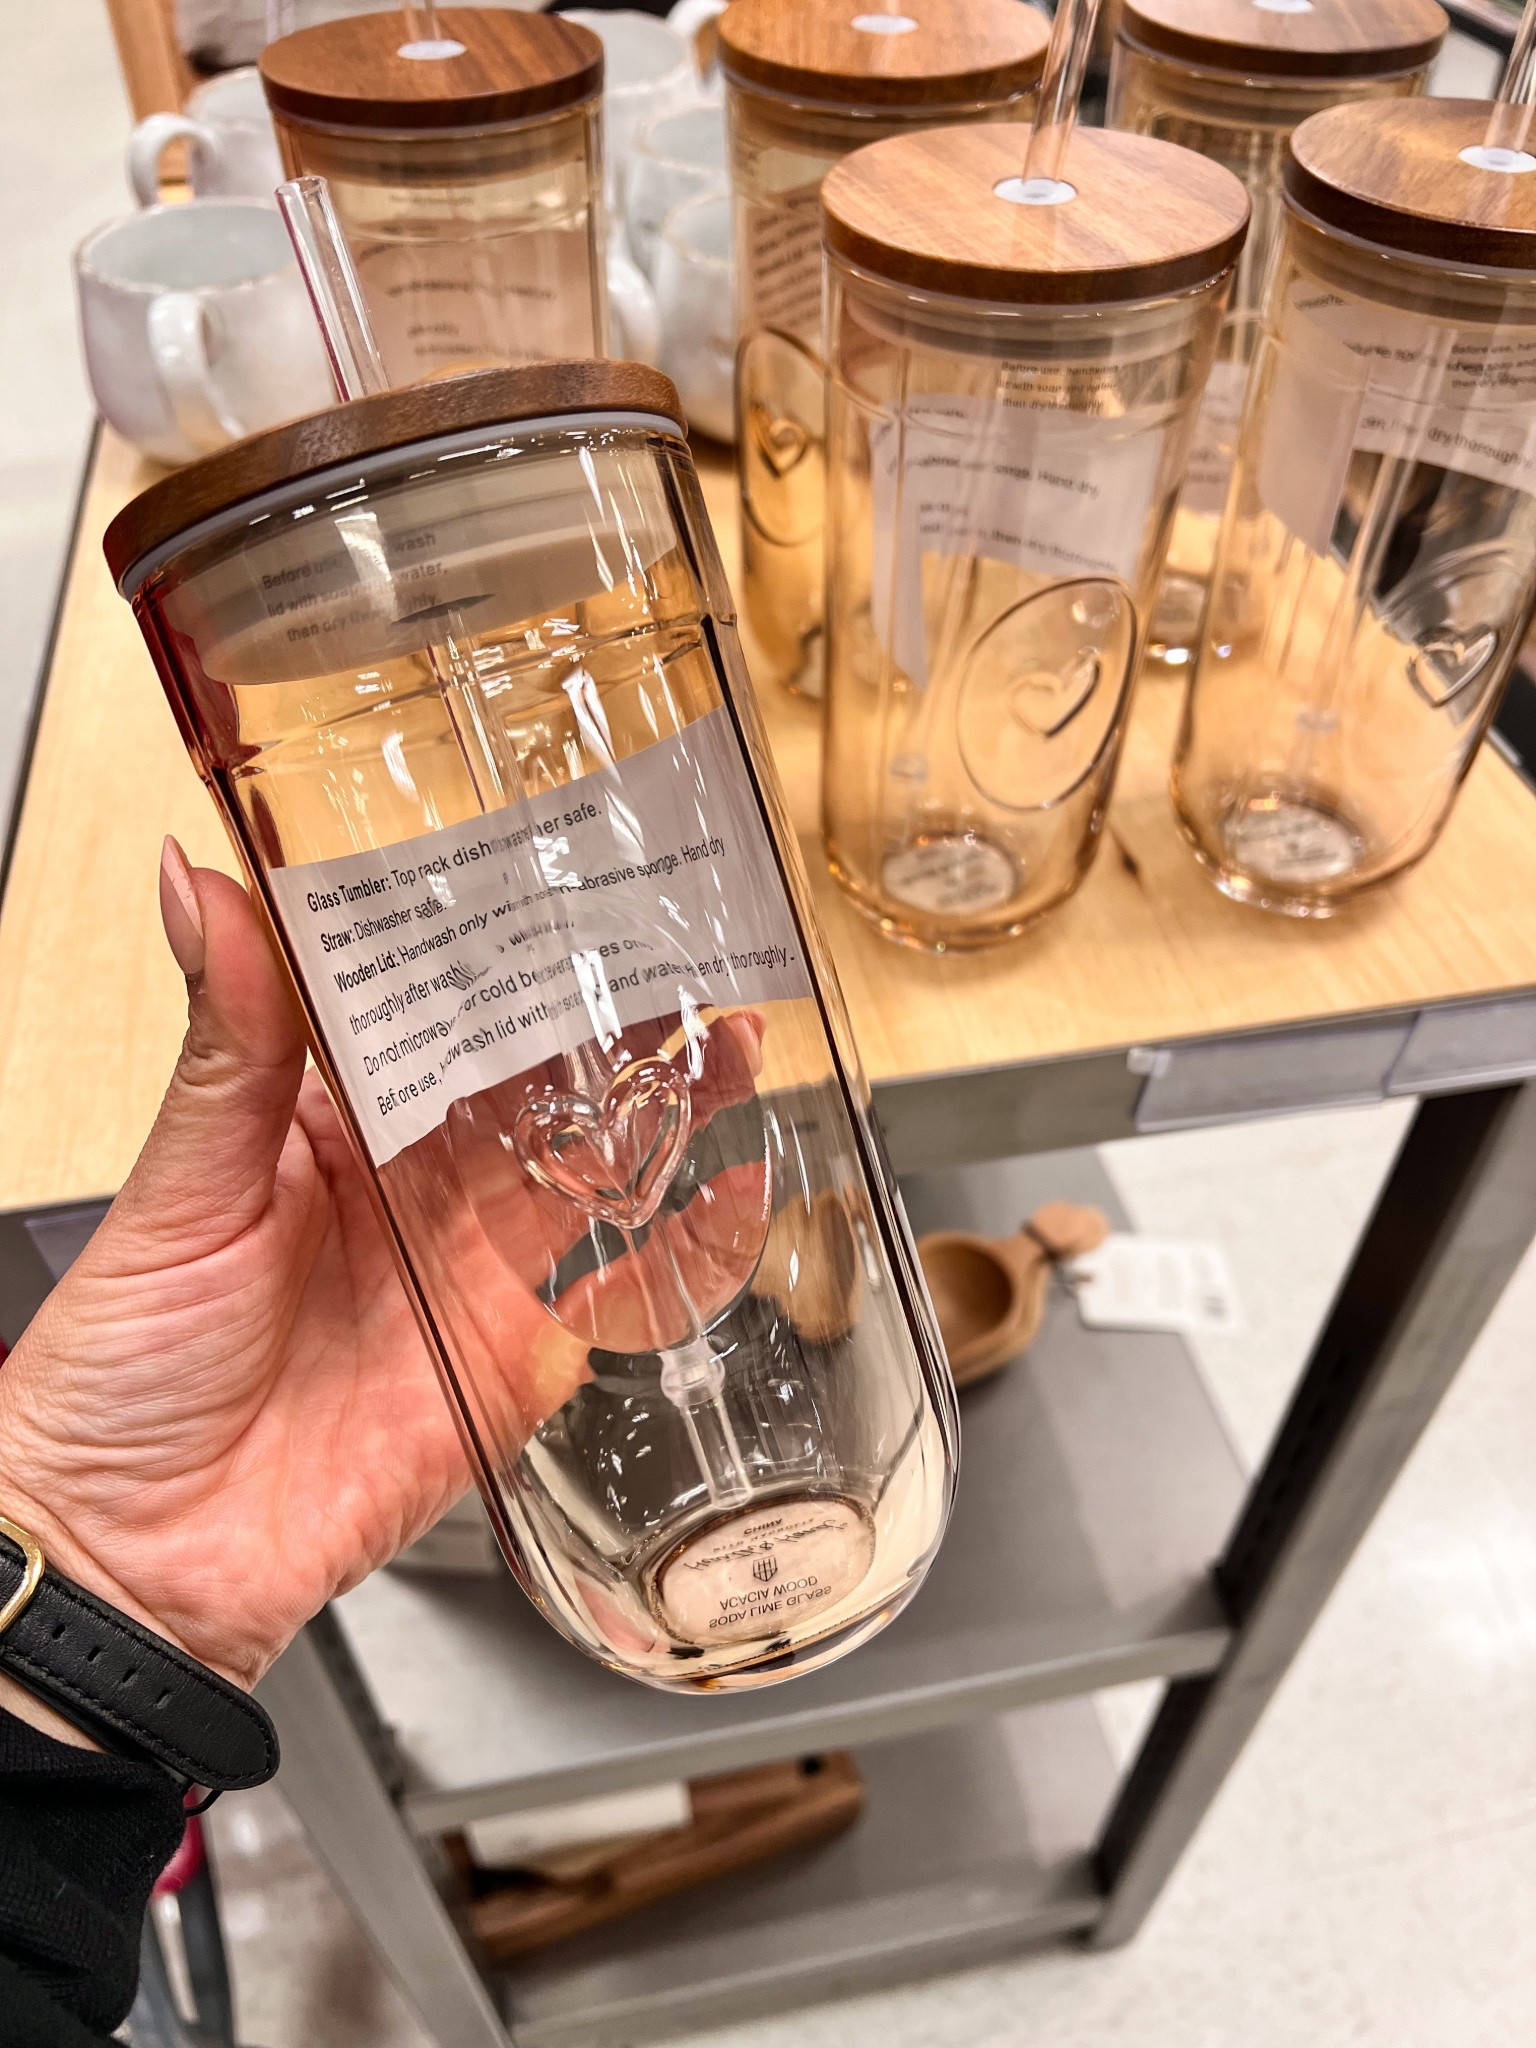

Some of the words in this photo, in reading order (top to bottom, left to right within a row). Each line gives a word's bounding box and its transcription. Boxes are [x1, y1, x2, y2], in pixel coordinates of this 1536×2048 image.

[307, 889, 341, 913] Glass
[339, 874, 393, 904] Tumbler:
[391, 866, 417, 888] Top
[418, 855, 451, 879] rack
[563, 802, 602, 827] safe.
[320, 929, 357, 953] Straw:
[356, 903, 413, 941] Dishwasher
[333, 958, 379, 993] Wooden
[376, 949, 402, 975] Lid:
[397, 926, 458, 964] Handwash
[457, 911, 489, 939] only
[680, 841, 710, 865] Hand
[708, 835, 726, 859] dry
[349, 992, 407, 1036] thoroughly
[404, 981, 431, 1006] after
[479, 969, 519, 1002] cold
[376, 1083, 420, 1117] Before
[495, 1015, 517, 1040] lid
[517, 1001, 550, 1029] with
[608, 967, 640, 993] and
